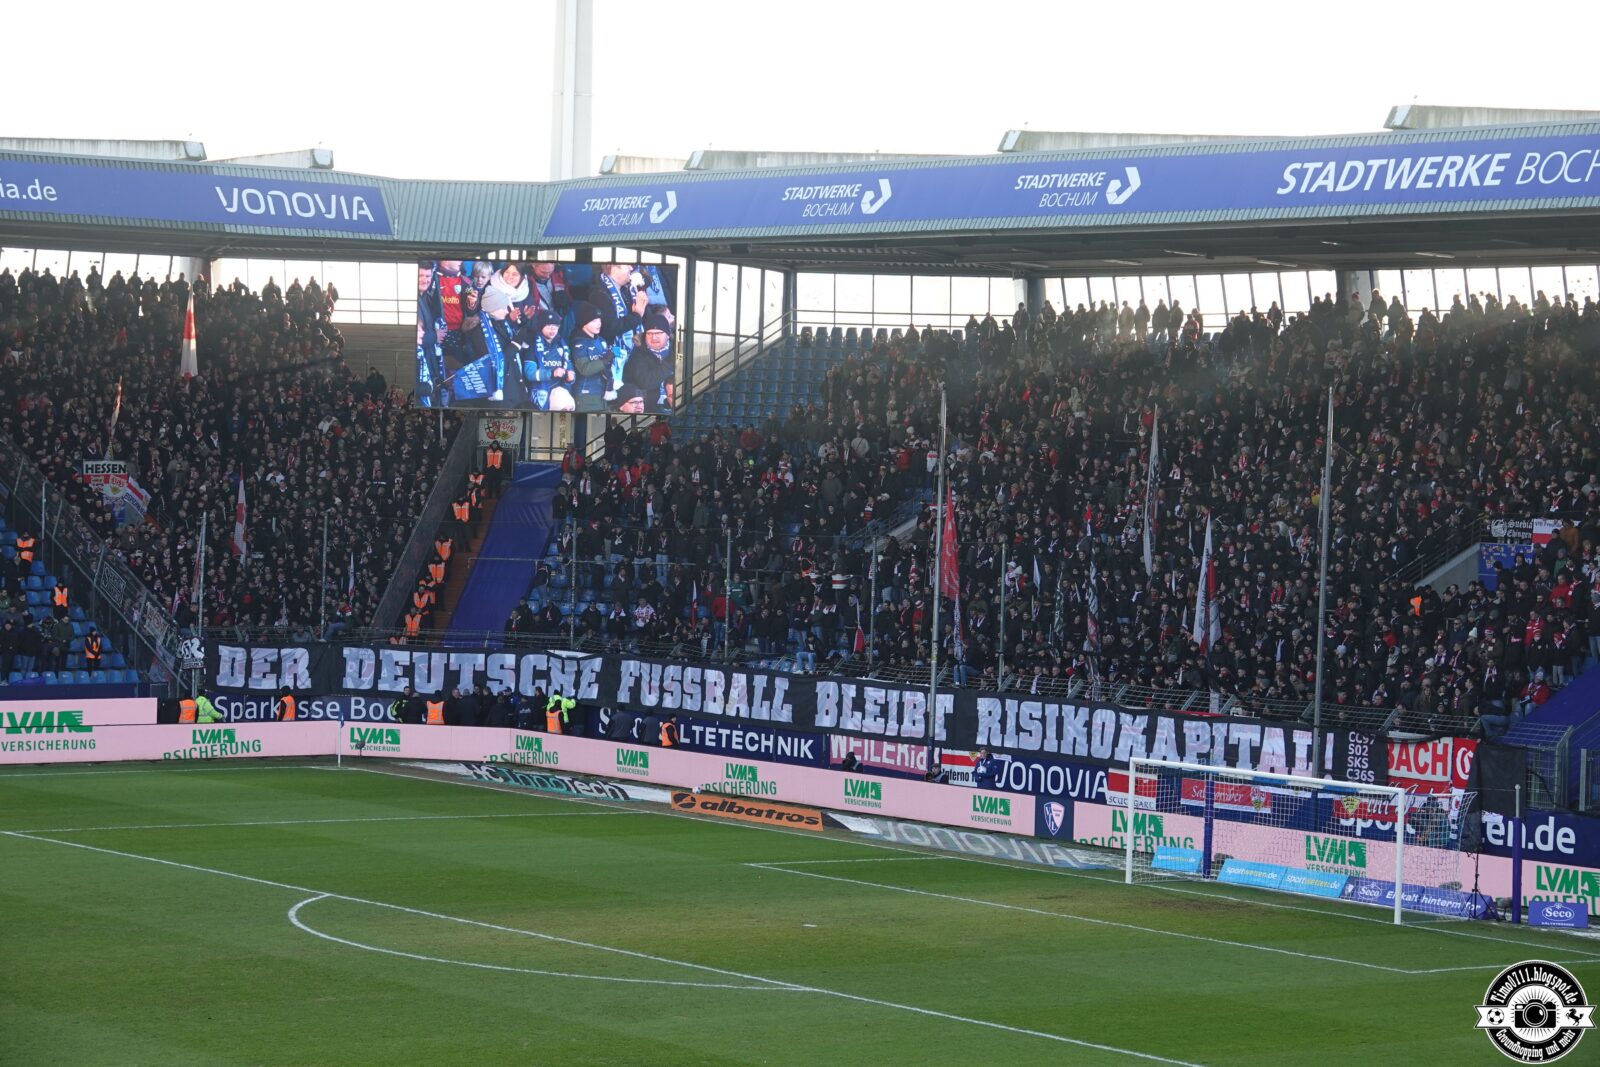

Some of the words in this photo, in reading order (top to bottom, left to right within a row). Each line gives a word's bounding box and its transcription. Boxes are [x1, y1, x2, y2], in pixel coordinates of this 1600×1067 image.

[1014, 172, 1106, 190] STADTWERKE
[1276, 152, 1511, 194] STADTWERKE
[782, 184, 862, 201] STADTWERKE
[1039, 191, 1098, 208] BOCHUM
[215, 185, 375, 222] VONOVIA
[582, 195, 652, 212] STADTWERKE
[802, 202, 853, 217] BOCHUM
[598, 213, 644, 227] BOCHUM
[85, 463, 127, 474] HESSEN
[216, 645, 312, 690] DER
[342, 647, 602, 700] DEUTSCHE
[616, 659, 793, 723] FUSSBALL
[814, 681, 955, 742] BLEIBT
[214, 695, 340, 722] Sparksse
[1, 739, 97, 752] VERSICHERUNG
[1348, 743, 1369, 756] S02
[1347, 756, 1369, 769] SKS
[1346, 768, 1375, 782] C36S
[844, 798, 882, 808] VERSICHERUNG
[700, 799, 820, 826] albatros
[970, 814, 1012, 827] VERSICHERUNG
[1305, 834, 1350, 866] LVM
[1535, 865, 1579, 895] LVM
[1359, 885, 1381, 898] Seco
[1545, 906, 1573, 919] Seco
